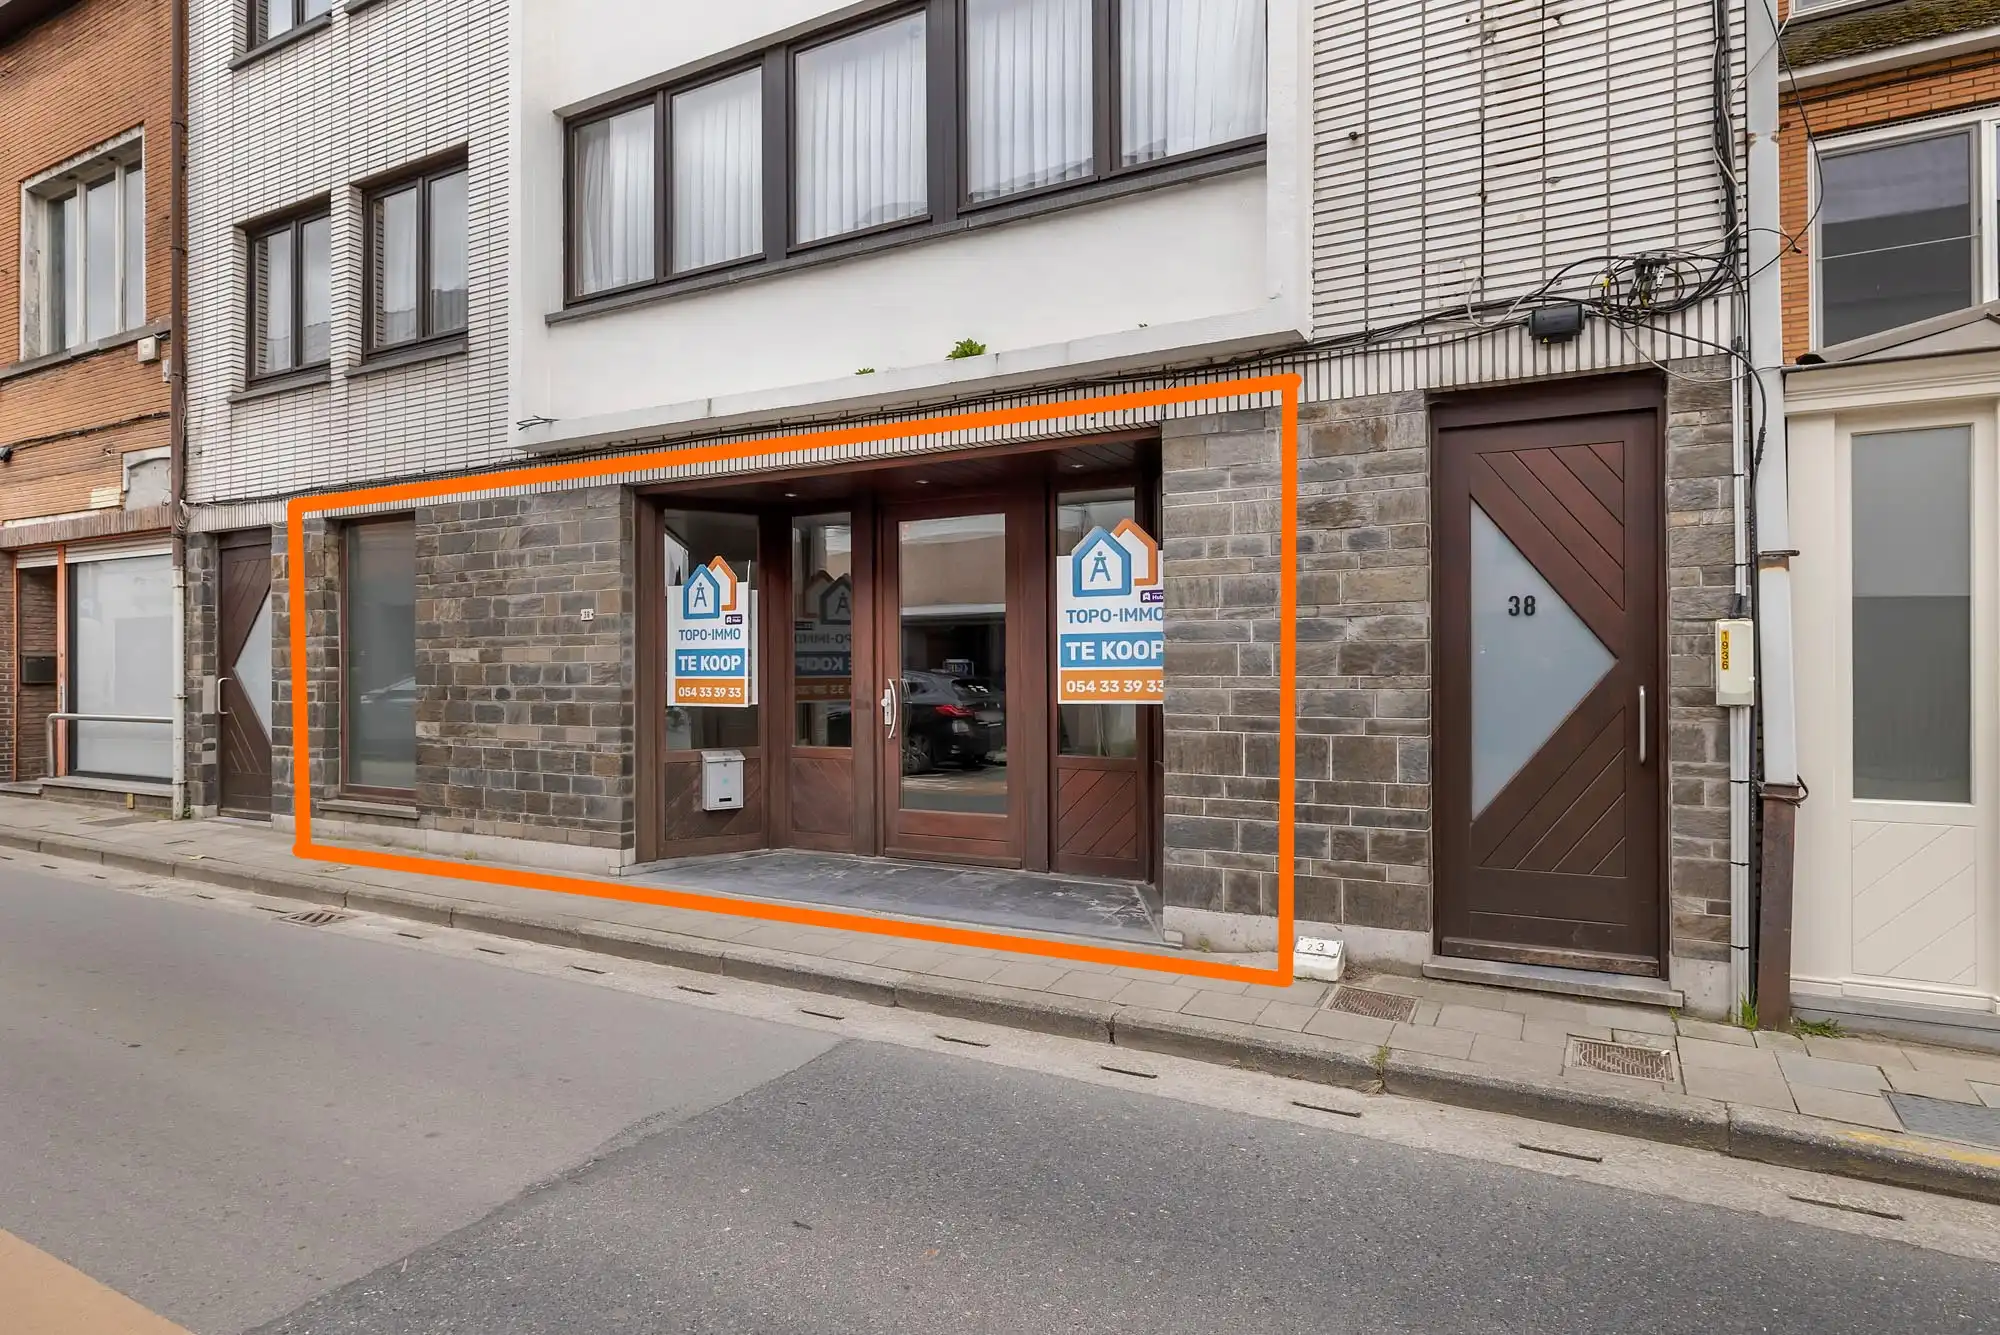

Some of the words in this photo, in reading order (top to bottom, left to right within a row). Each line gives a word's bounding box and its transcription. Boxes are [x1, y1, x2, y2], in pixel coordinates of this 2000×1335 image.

[1508, 595, 1536, 616] 38
[1066, 607, 1163, 624] TOPO-IMMO
[679, 628, 741, 641] TOPO-IMMO
[1065, 641, 1096, 660] TE
[1101, 640, 1163, 660] KOOP
[1721, 631, 1729, 670] 1936
[678, 655, 697, 671] TE
[700, 655, 741, 671] KOOP
[678, 687, 697, 697] 054
[699, 687, 712, 697] 33
[713, 687, 726, 697] 39
[728, 686, 742, 697] 33
[1066, 680, 1096, 693] 054
[1100, 680, 1120, 693] 33
[1123, 680, 1143, 692] 39
[1146, 680, 1164, 692] 33
